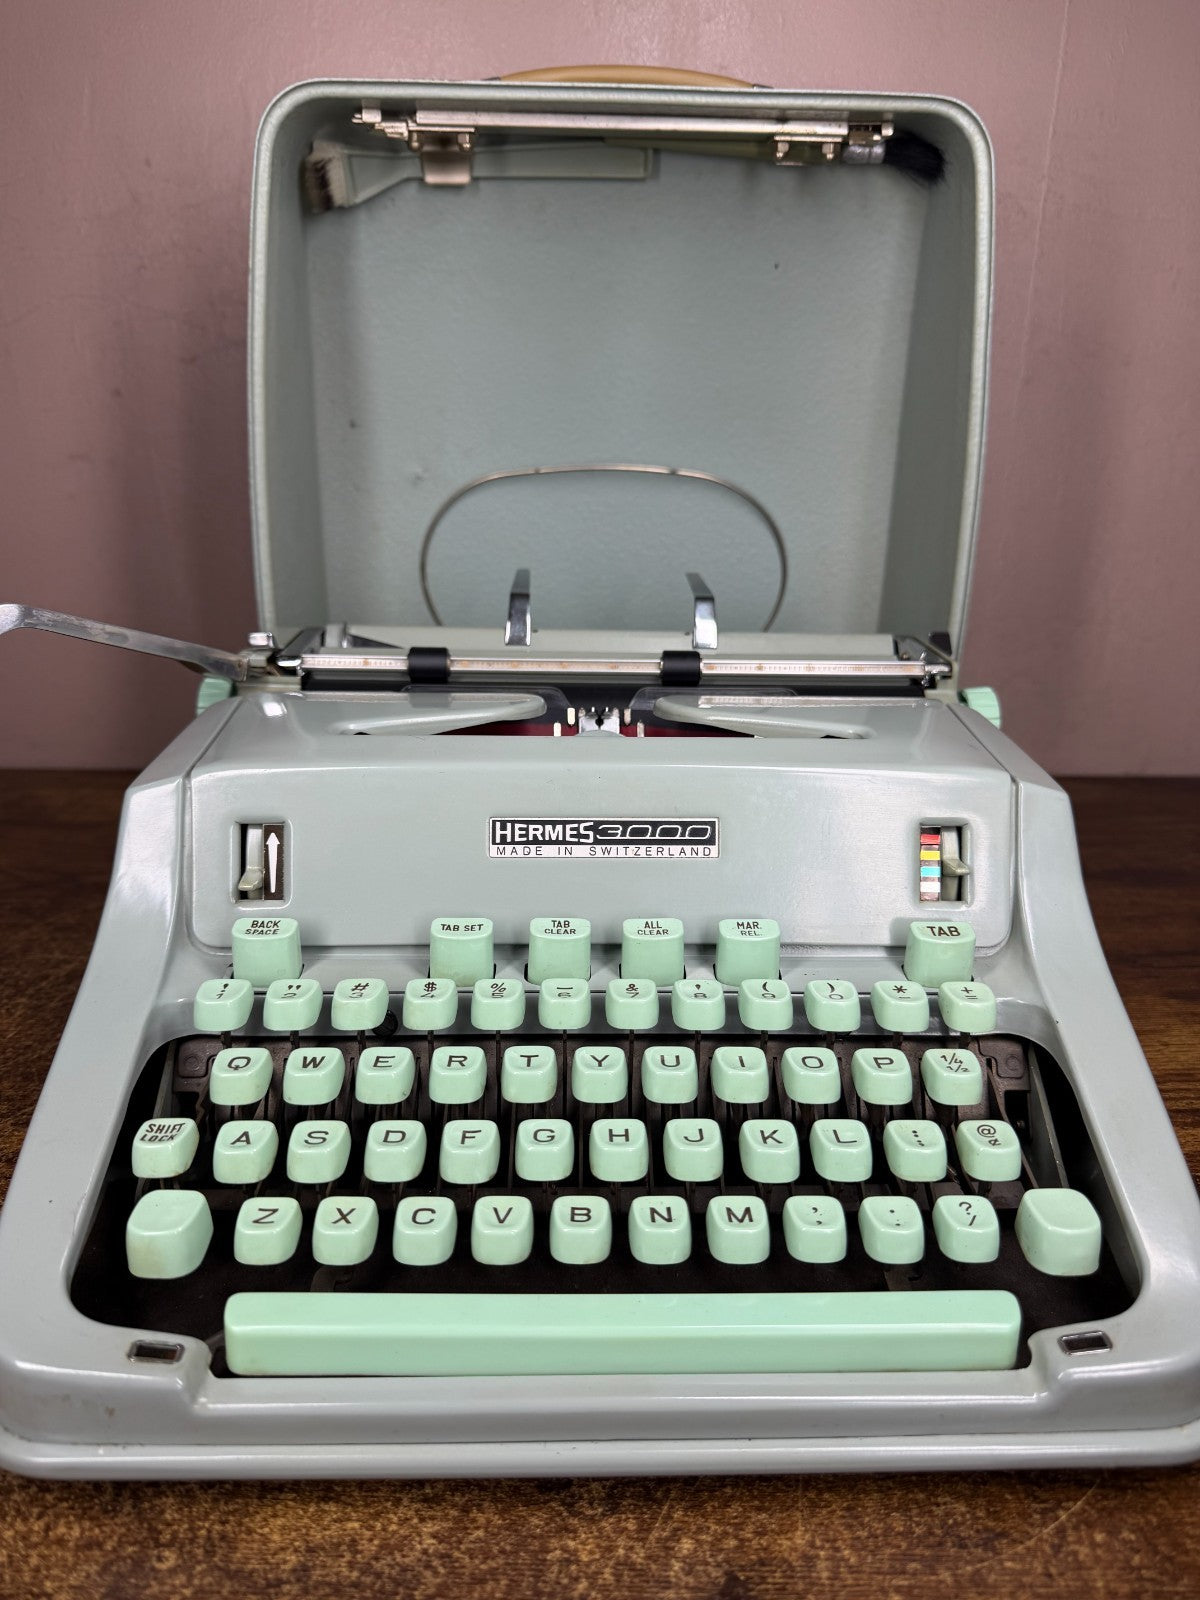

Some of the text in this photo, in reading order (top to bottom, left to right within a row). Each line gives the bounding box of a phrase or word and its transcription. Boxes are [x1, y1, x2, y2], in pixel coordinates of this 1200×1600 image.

[495, 821, 711, 844] HERMES 3000
[496, 846, 712, 857] MADE IN SWITZERLAND
[251, 920, 281, 930] BACK
[551, 920, 571, 928] TAB
[643, 921, 664, 929] ALL
[927, 926, 960, 936] TAB
[221, 982, 231, 993] !
[350, 982, 370, 991] #
[424, 982, 437, 992] $
[491, 983, 506, 992] %
[625, 983, 639, 991] &
[761, 981, 770, 992] (
[826, 982, 835, 992] )
[960, 986, 974, 994] +
[625, 991, 640, 999] 7
[227, 1057, 251, 1070] Q
[302, 1056, 325, 1068] W
[373, 1056, 395, 1068] E
[447, 1055, 467, 1067] R
[520, 1055, 539, 1067] T
[591, 1055, 609, 1067] Y
[661, 1055, 680, 1067] U
[738, 1055, 746, 1068] I
[802, 1056, 823, 1068] O
[873, 1057, 894, 1069] P
[146, 1122, 186, 1135] SHIFT
[977, 1124, 996, 1138] @
[140, 1133, 177, 1142] LOCK
[230, 1131, 252, 1145] A
[304, 1131, 329, 1145] S
[383, 1130, 406, 1143] D
[461, 1130, 481, 1144] F
[533, 1129, 555, 1142] G
[609, 1129, 629, 1142] H
[684, 1129, 704, 1143] J
[760, 1130, 783, 1144] K
[833, 1130, 857, 1143] L
[570, 1207, 591, 1222] B
[959, 1202, 972, 1215] ?
[252, 1208, 278, 1224] Z
[332, 1208, 355, 1224] X
[412, 1208, 436, 1225] C
[493, 1207, 512, 1223] V
[650, 1207, 671, 1223] N
[726, 1207, 753, 1223] M
[968, 1215, 977, 1227] /
